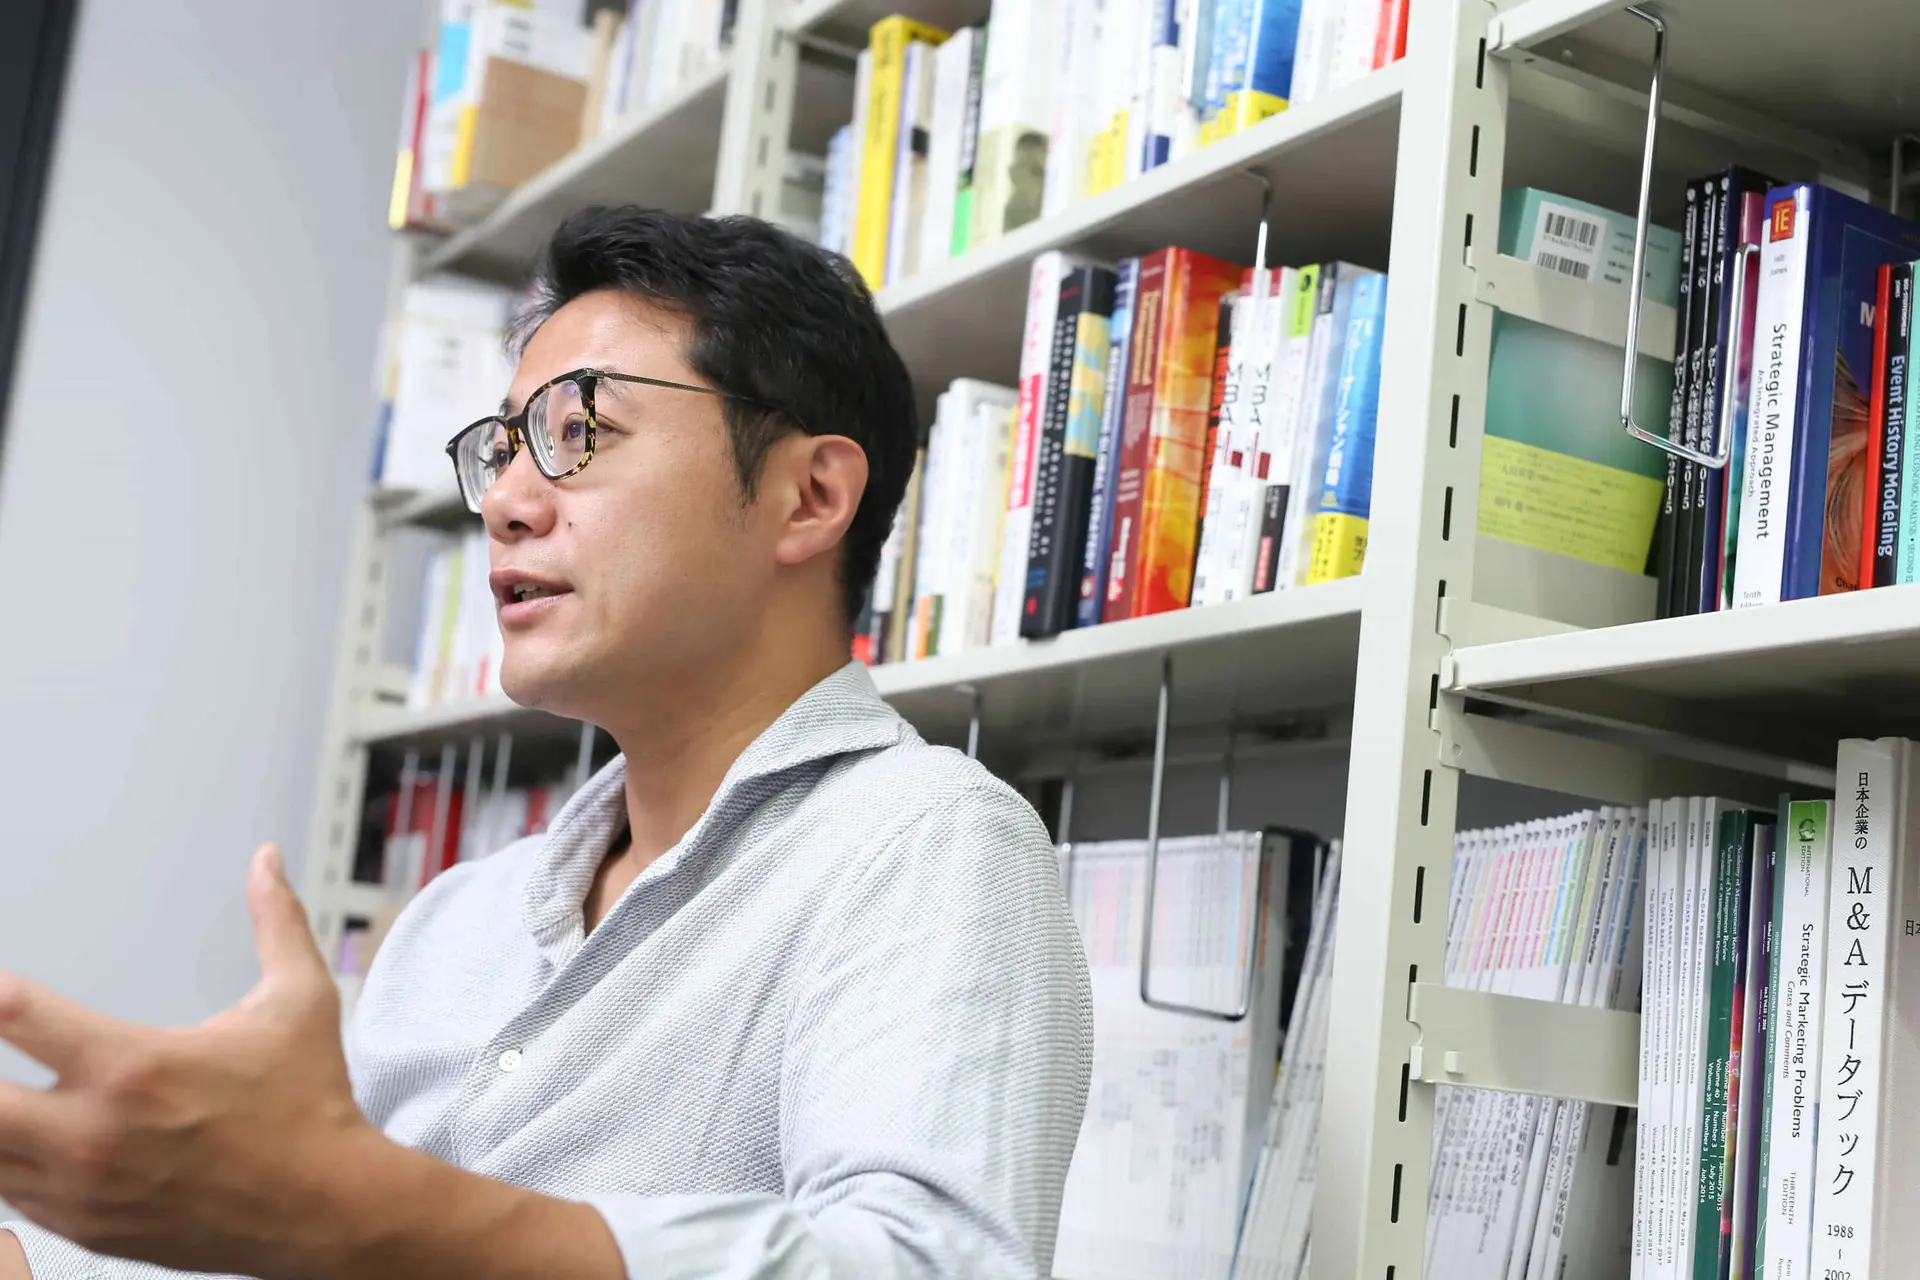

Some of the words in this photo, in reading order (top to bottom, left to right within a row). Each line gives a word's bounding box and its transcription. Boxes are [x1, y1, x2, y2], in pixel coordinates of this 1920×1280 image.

[1775, 208, 1790, 232] IE
[1765, 323, 1788, 408] Strategic
[1890, 354, 1904, 405] Event
[1752, 384, 1762, 443] Integrated
[1882, 407, 1904, 470] History
[1748, 448, 1758, 498] Approach
[1756, 413, 1780, 540] Management
[1878, 475, 1900, 557] Modeling
[1744, 590, 1762, 600] Tenth
[1854, 772, 1870, 850] 日本企業の
[1602, 837, 1617, 880] Harvard
[1804, 845, 1812, 898] INTERNATIONAL
[1595, 881, 1608, 924] Business
[1723, 888, 1732, 933] Management
[1588, 926, 1600, 965] Review
[1798, 924, 1814, 986] Strategic
[1786, 980, 1796, 1008] Cases
[1792, 992, 1810, 1064] Marketing
[1832, 866, 1874, 1196] M&Aデータブック
[1714, 1058, 1722, 1087] Volume
[1783, 1030, 1793, 1078] Comments
[1706, 1062, 1714, 1091] Volume
[1706, 1092, 1712, 1102] 39
[1714, 1088, 1720, 1098] 40
[1792, 1070, 1806, 1138] Problems
[1712, 1110, 1720, 1142] Number
[1720, 1111, 1728, 1143] Number
[1700, 1168, 1708, 1182] July
[1708, 1164, 1716, 1180] July
[1718, 1162, 1726, 1194] January
[1716, 1195, 1724, 1212] 2015
[1788, 1172, 1796, 1225] THIRTEENTH
[1827, 1224, 1854, 1239] 1988
